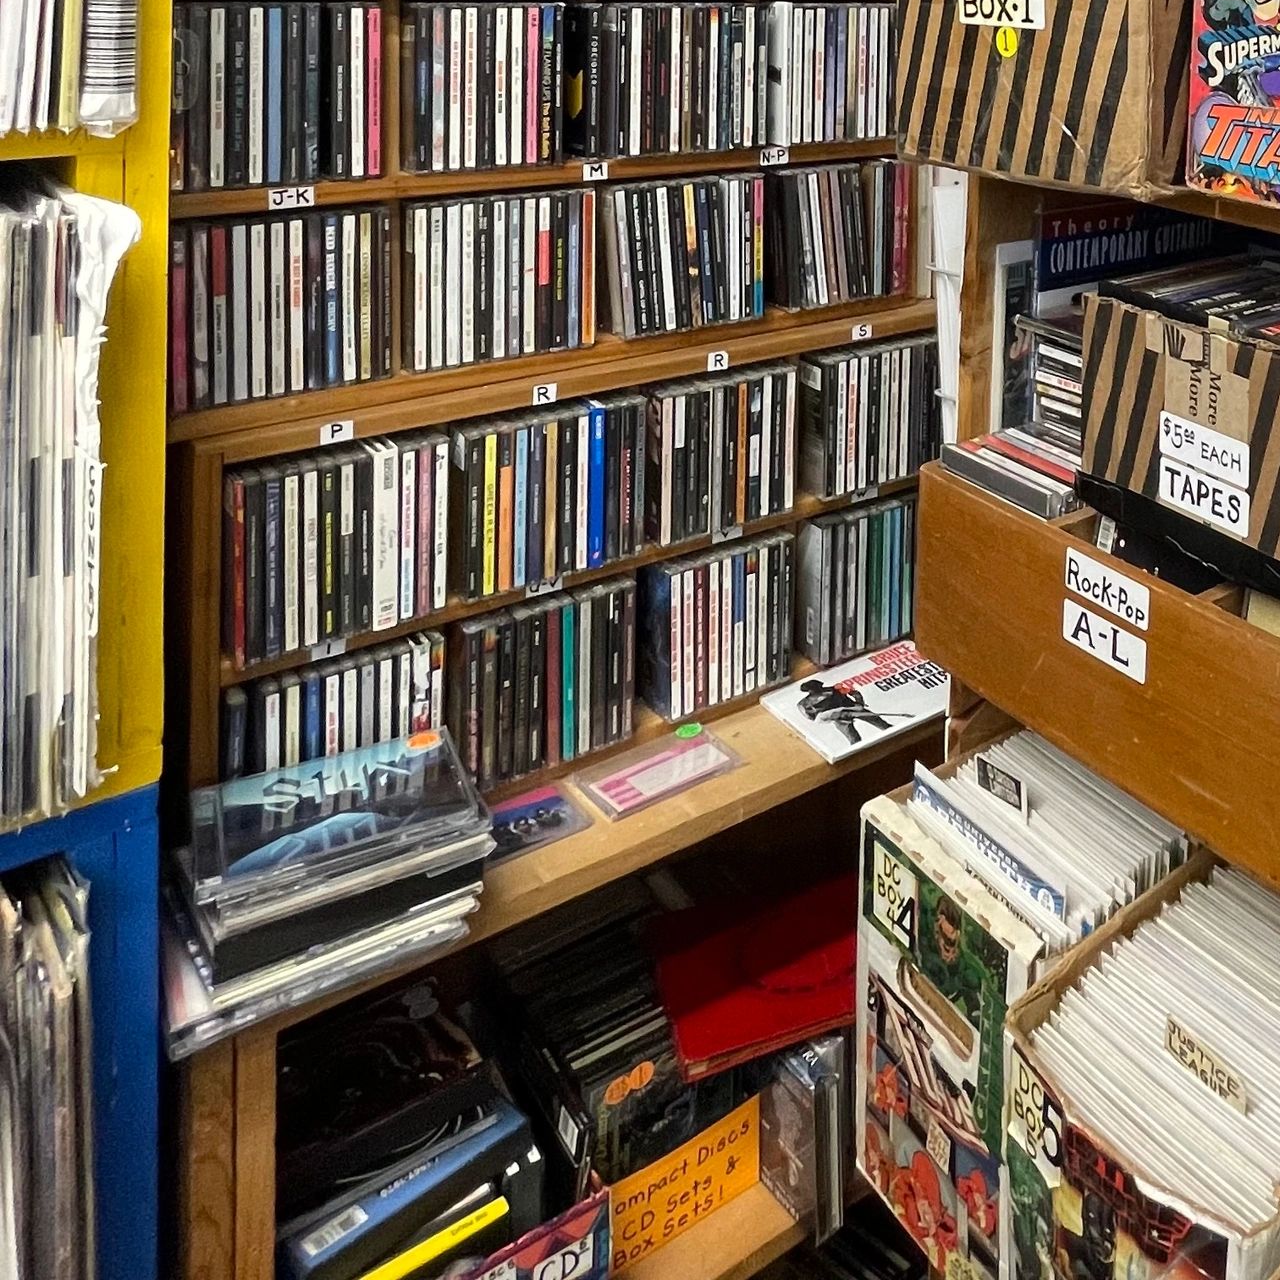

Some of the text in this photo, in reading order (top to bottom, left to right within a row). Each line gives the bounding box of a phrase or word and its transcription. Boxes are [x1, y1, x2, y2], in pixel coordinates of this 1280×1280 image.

[588, 164, 606, 179] M
[762, 149, 786, 165] N-P
[1052, 213, 1134, 238] Theory
[1050, 229, 1150, 274] CONTEMPORARY
[859, 265, 868, 338] S
[713, 354, 725, 368] R
[538, 386, 551, 401] R
[1206, 371, 1222, 426] More
[331, 424, 344, 440] P
[1201, 442, 1242, 473] EACH
[1165, 466, 1242, 525] TAPES
[867, 642, 916, 666] BRUCE
[1070, 611, 1131, 669] A-L
[874, 660, 940, 693] GREATEST
[917, 669, 948, 690] HITS
[882, 852, 902, 885] DC
[1018, 1061, 1043, 1112] DC
[1038, 1089, 1065, 1168] 5
[614, 1120, 751, 1217] ompact Discs
[622, 1154, 740, 1241] CD Sets &
[614, 1186, 724, 1270] Box Sets!
